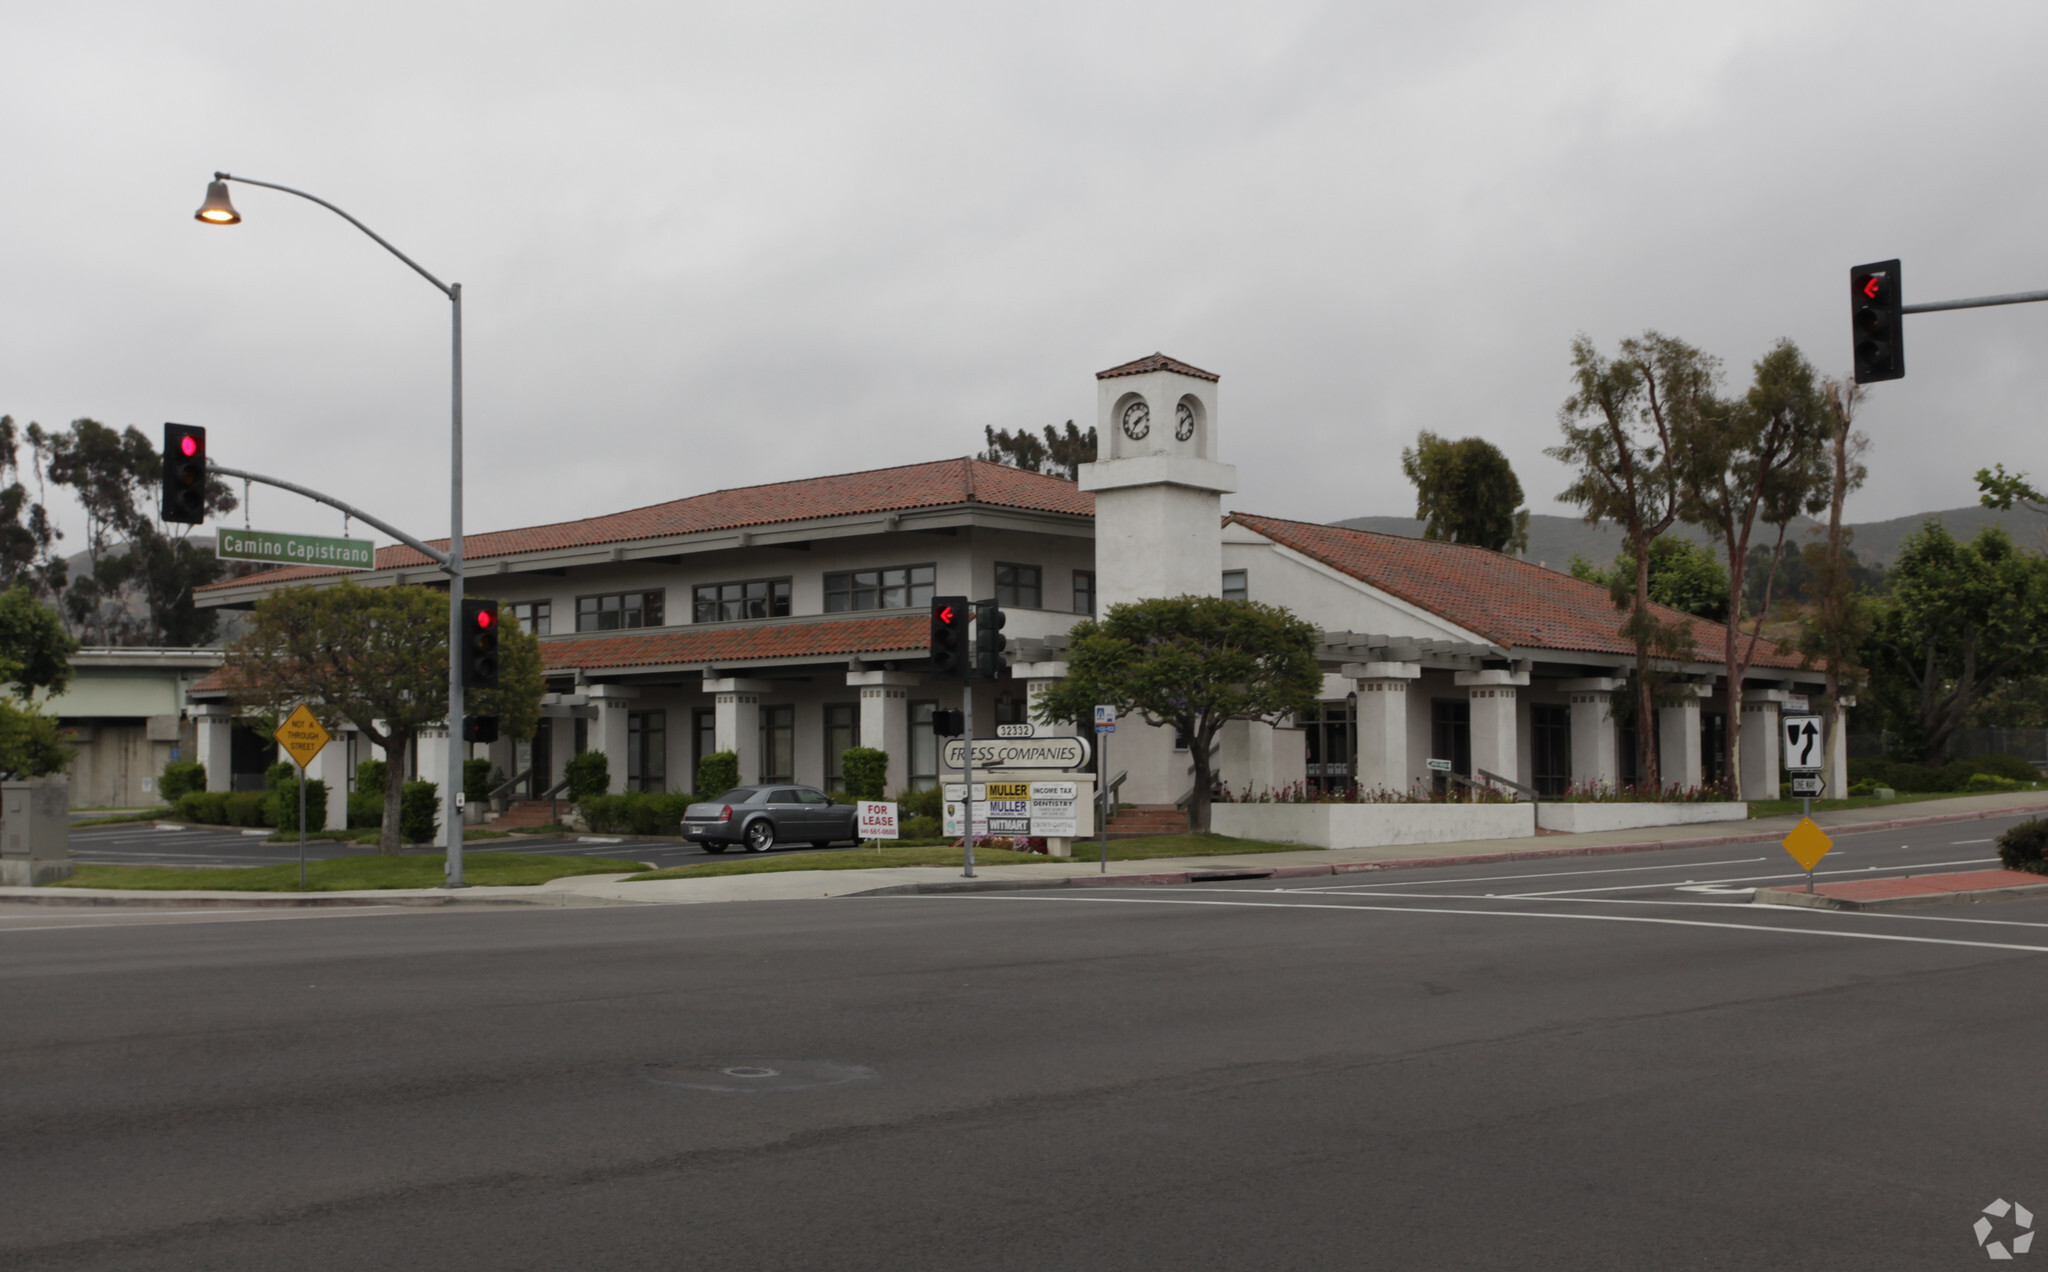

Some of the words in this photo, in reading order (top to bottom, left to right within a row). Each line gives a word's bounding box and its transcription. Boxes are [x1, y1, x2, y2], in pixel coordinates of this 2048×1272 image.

[224, 535, 282, 556] Camino
[287, 540, 369, 563] Capistrano
[291, 720, 305, 728] NOT
[288, 731, 319, 740] THROUGH
[1000, 725, 1029, 736] 32332
[291, 742, 315, 750] STREET
[950, 747, 995, 761] FRESS
[998, 746, 1076, 761] COMPANIES
[989, 784, 1028, 796] MULLER
[1794, 779, 1805, 790] ONE
[1806, 779, 1816, 790] WAY
[867, 804, 888, 815] FOR
[990, 801, 1027, 812] MULLER
[862, 816, 894, 826] LEASE
[989, 819, 1029, 831] WITMART
